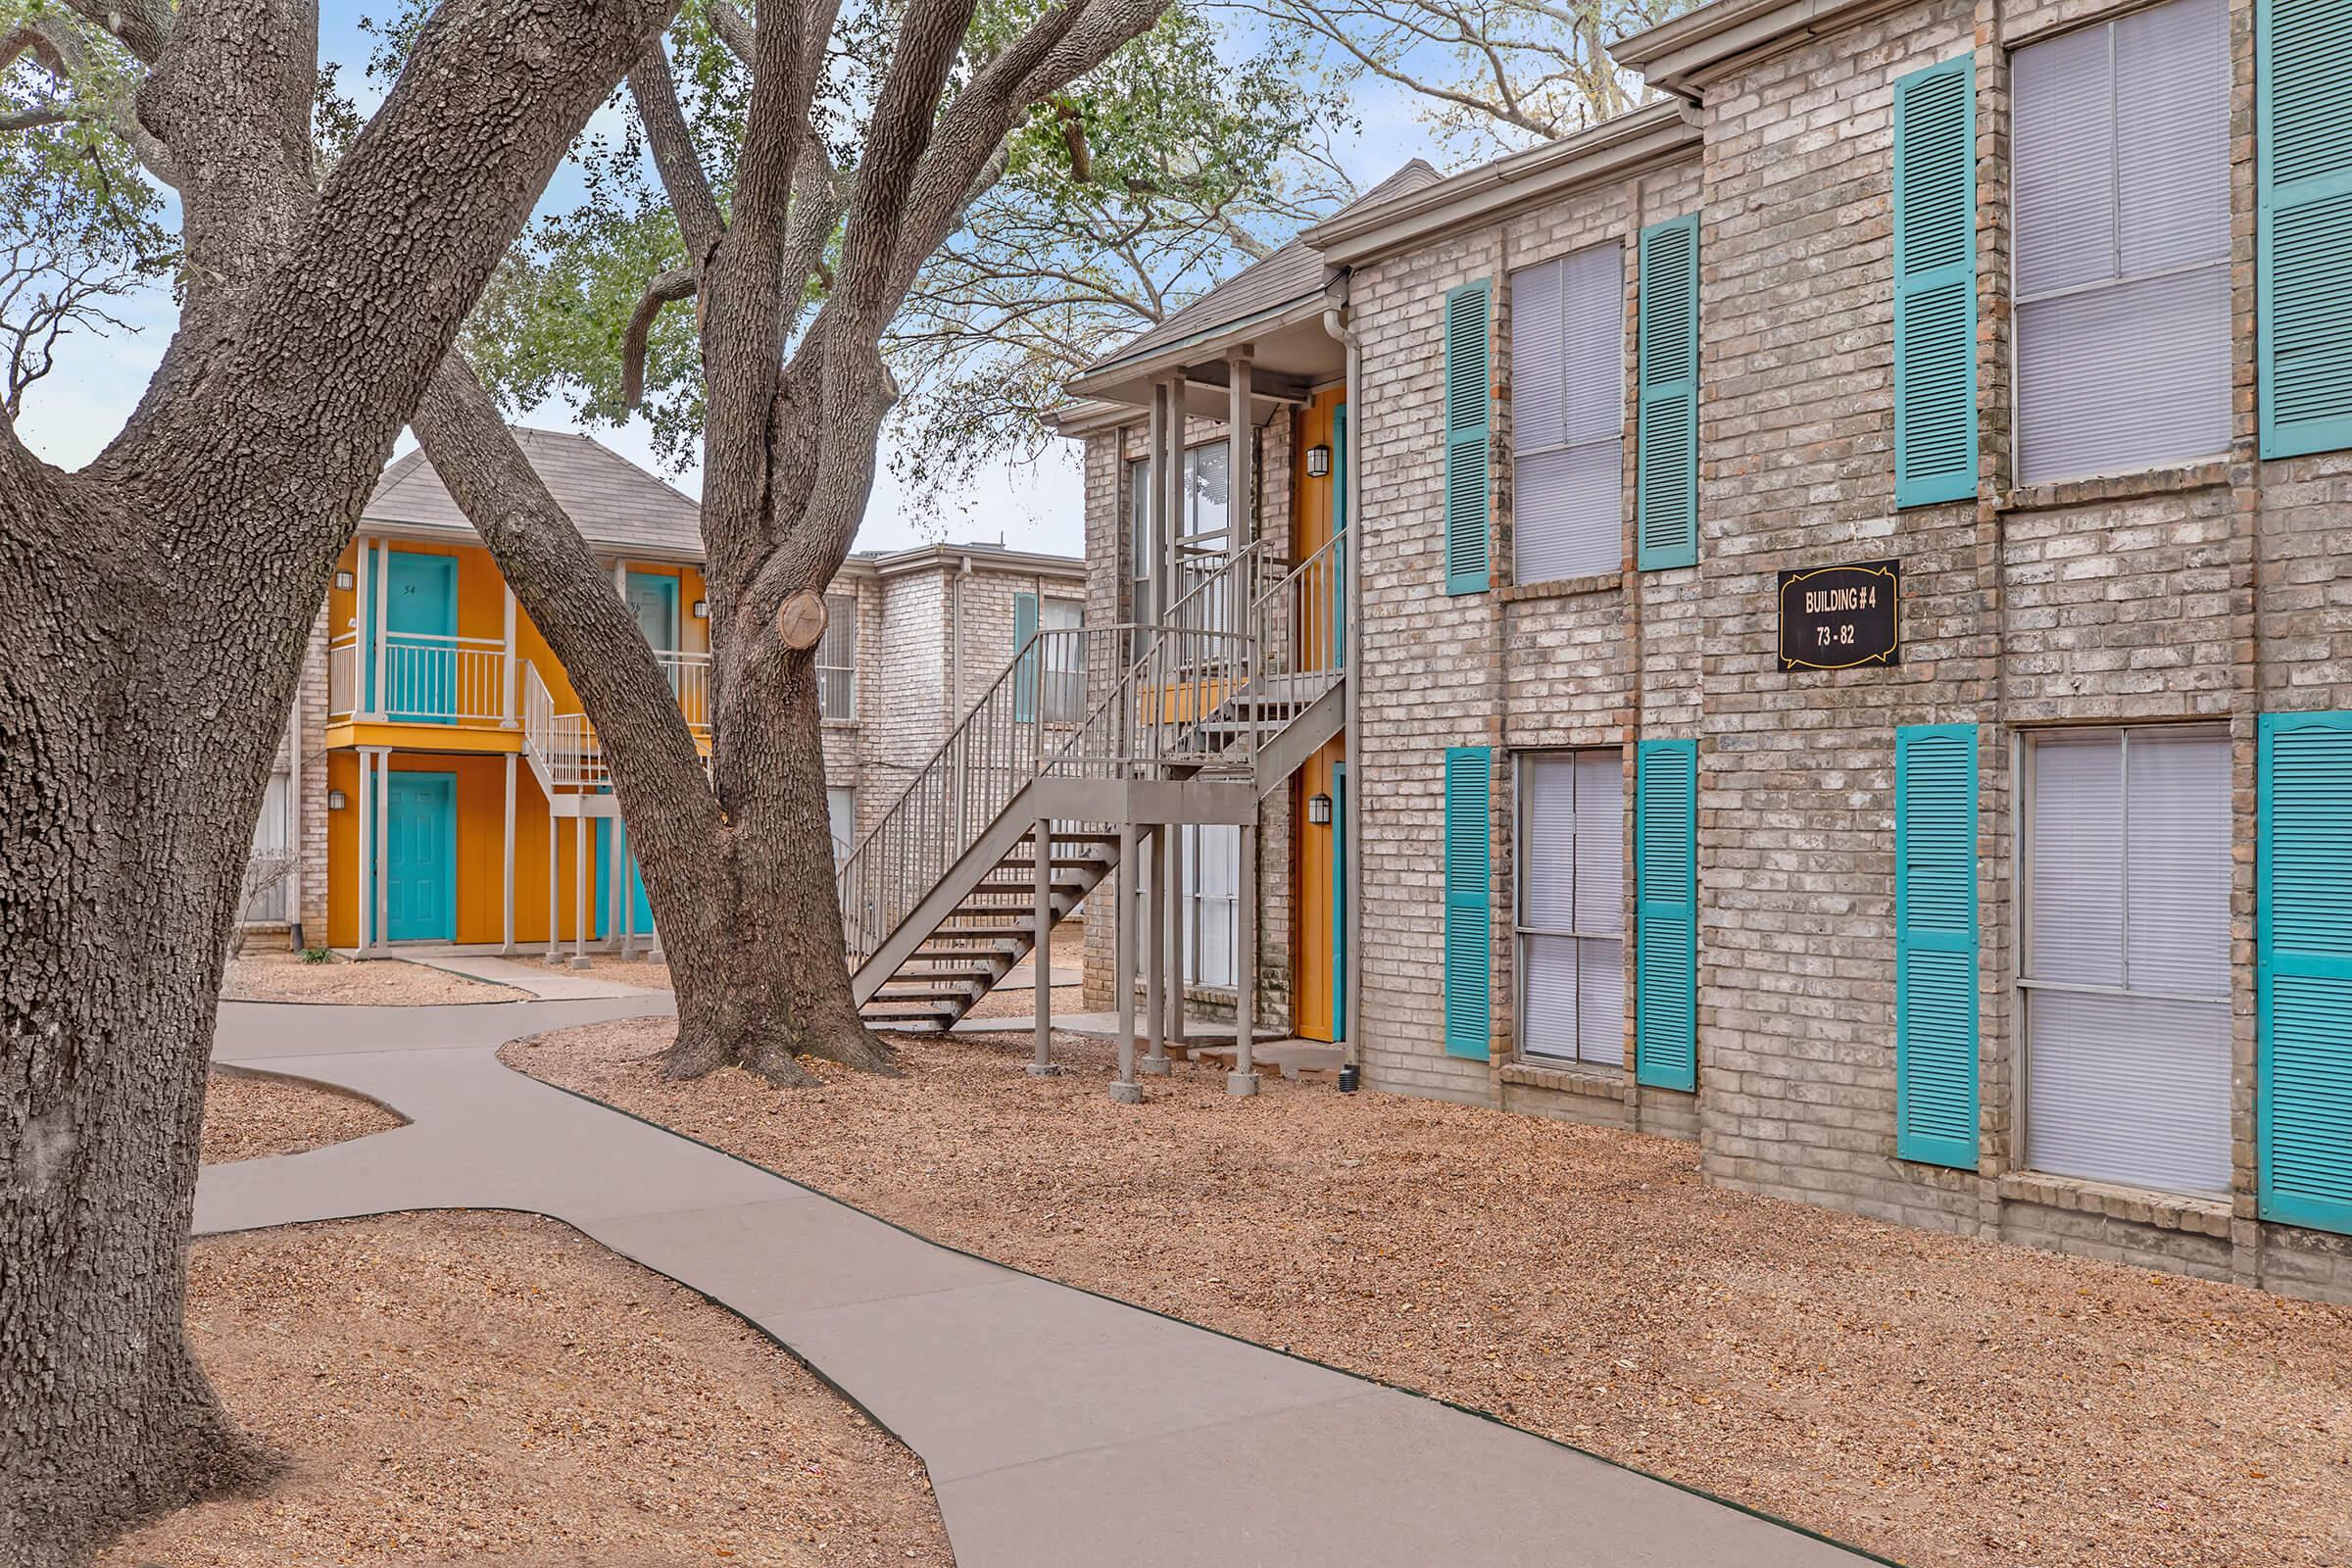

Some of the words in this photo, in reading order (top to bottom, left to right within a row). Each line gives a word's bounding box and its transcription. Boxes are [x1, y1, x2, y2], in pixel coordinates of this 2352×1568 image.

[1806, 588, 1857, 612] BUILDING
[1817, 626, 1831, 646] 73
[1840, 624, 1854, 645] 82
